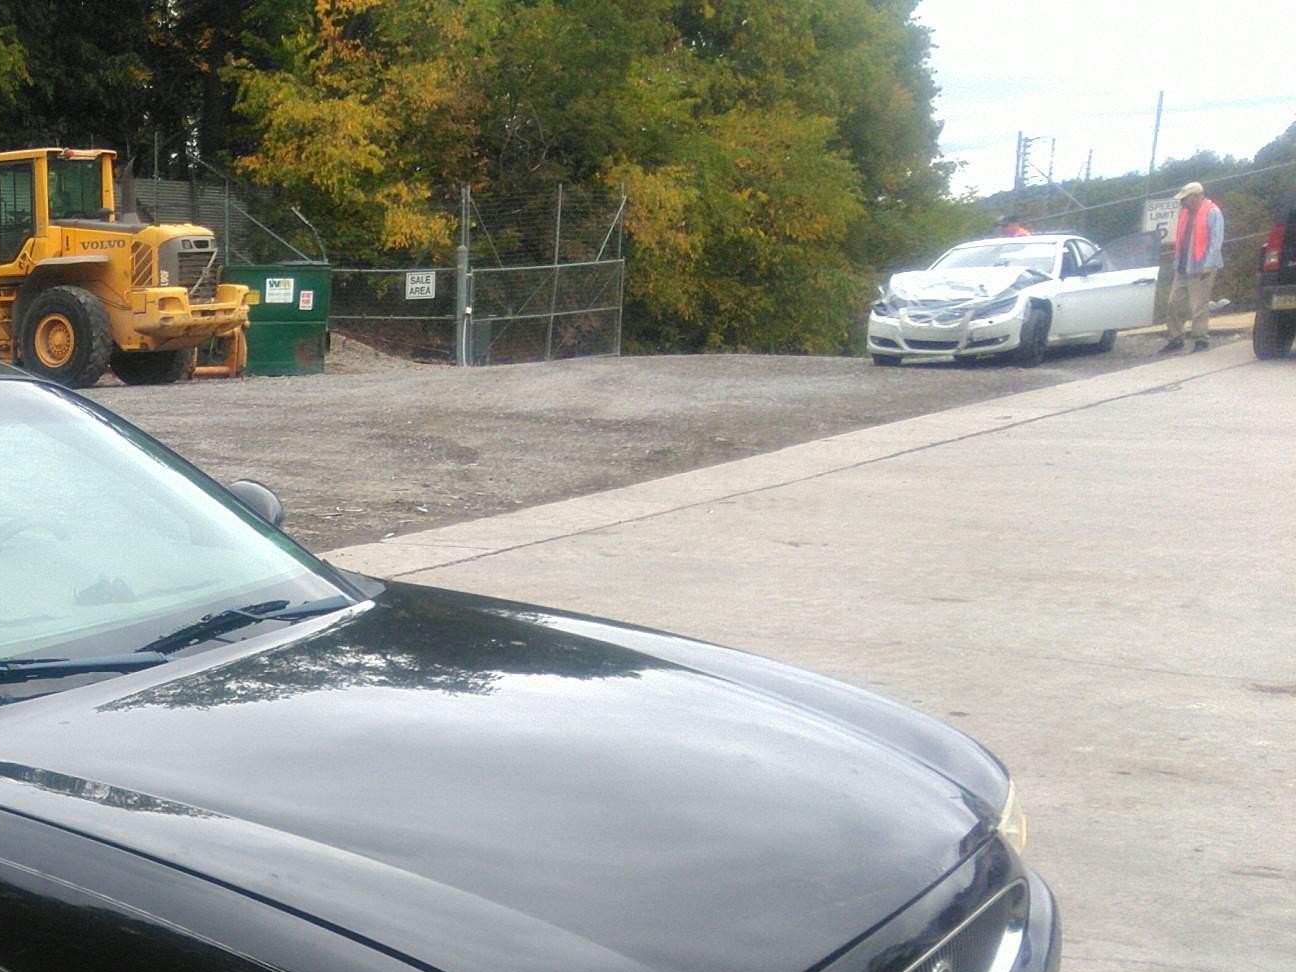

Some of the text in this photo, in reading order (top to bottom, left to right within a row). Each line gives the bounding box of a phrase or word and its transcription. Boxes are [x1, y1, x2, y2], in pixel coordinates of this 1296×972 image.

[80, 239, 126, 250] VOLVO
[409, 275, 432, 285] SALE
[409, 285, 432, 295] AREA
